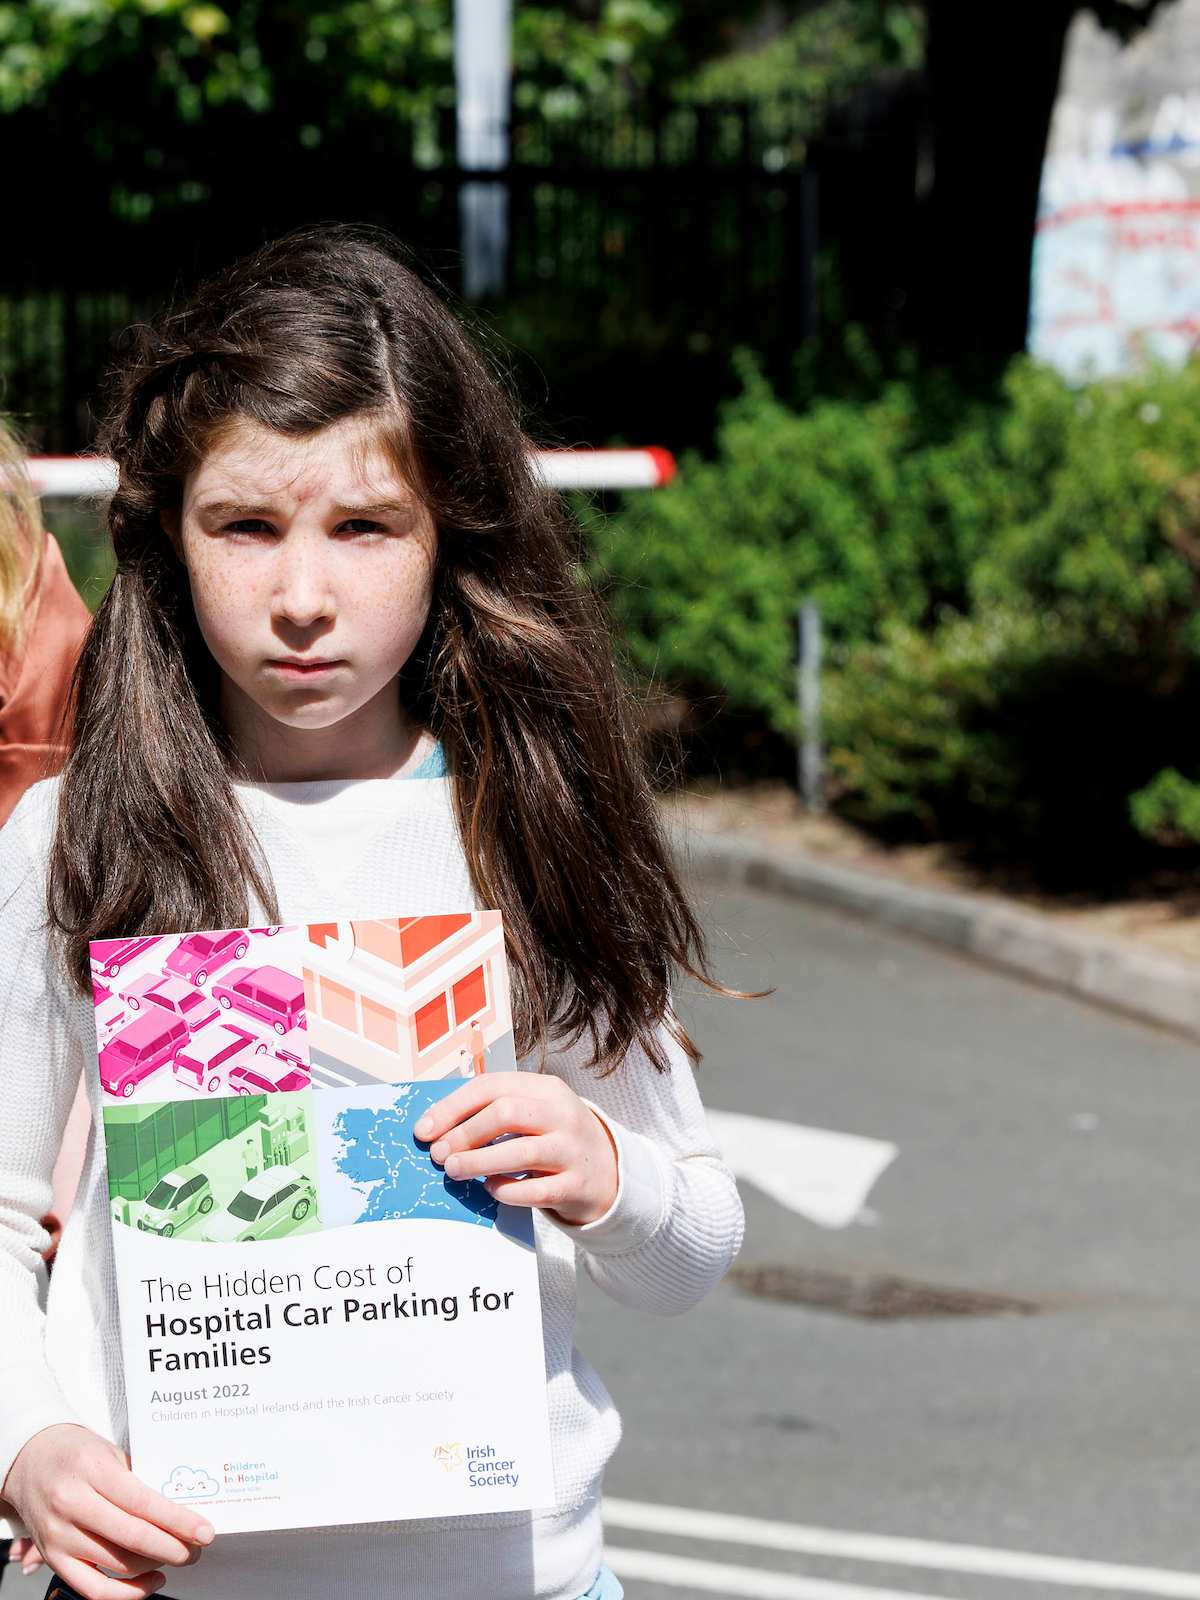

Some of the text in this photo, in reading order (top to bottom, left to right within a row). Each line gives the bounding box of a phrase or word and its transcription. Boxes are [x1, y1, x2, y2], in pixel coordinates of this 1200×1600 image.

[141, 1257, 415, 1303] The Hidden Cost of
[145, 1286, 515, 1340] Hospital Car Parking for
[148, 1342, 272, 1373] Families
[150, 1383, 251, 1405] August 2022
[151, 1389, 455, 1422] Children in Hospital Ireland and the Irish Cancer Society
[467, 1445, 495, 1458] Irish
[223, 1462, 266, 1472] Children
[468, 1460, 516, 1473] Cancer
[224, 1471, 279, 1484] In Hospital
[469, 1473, 519, 1487] Society
